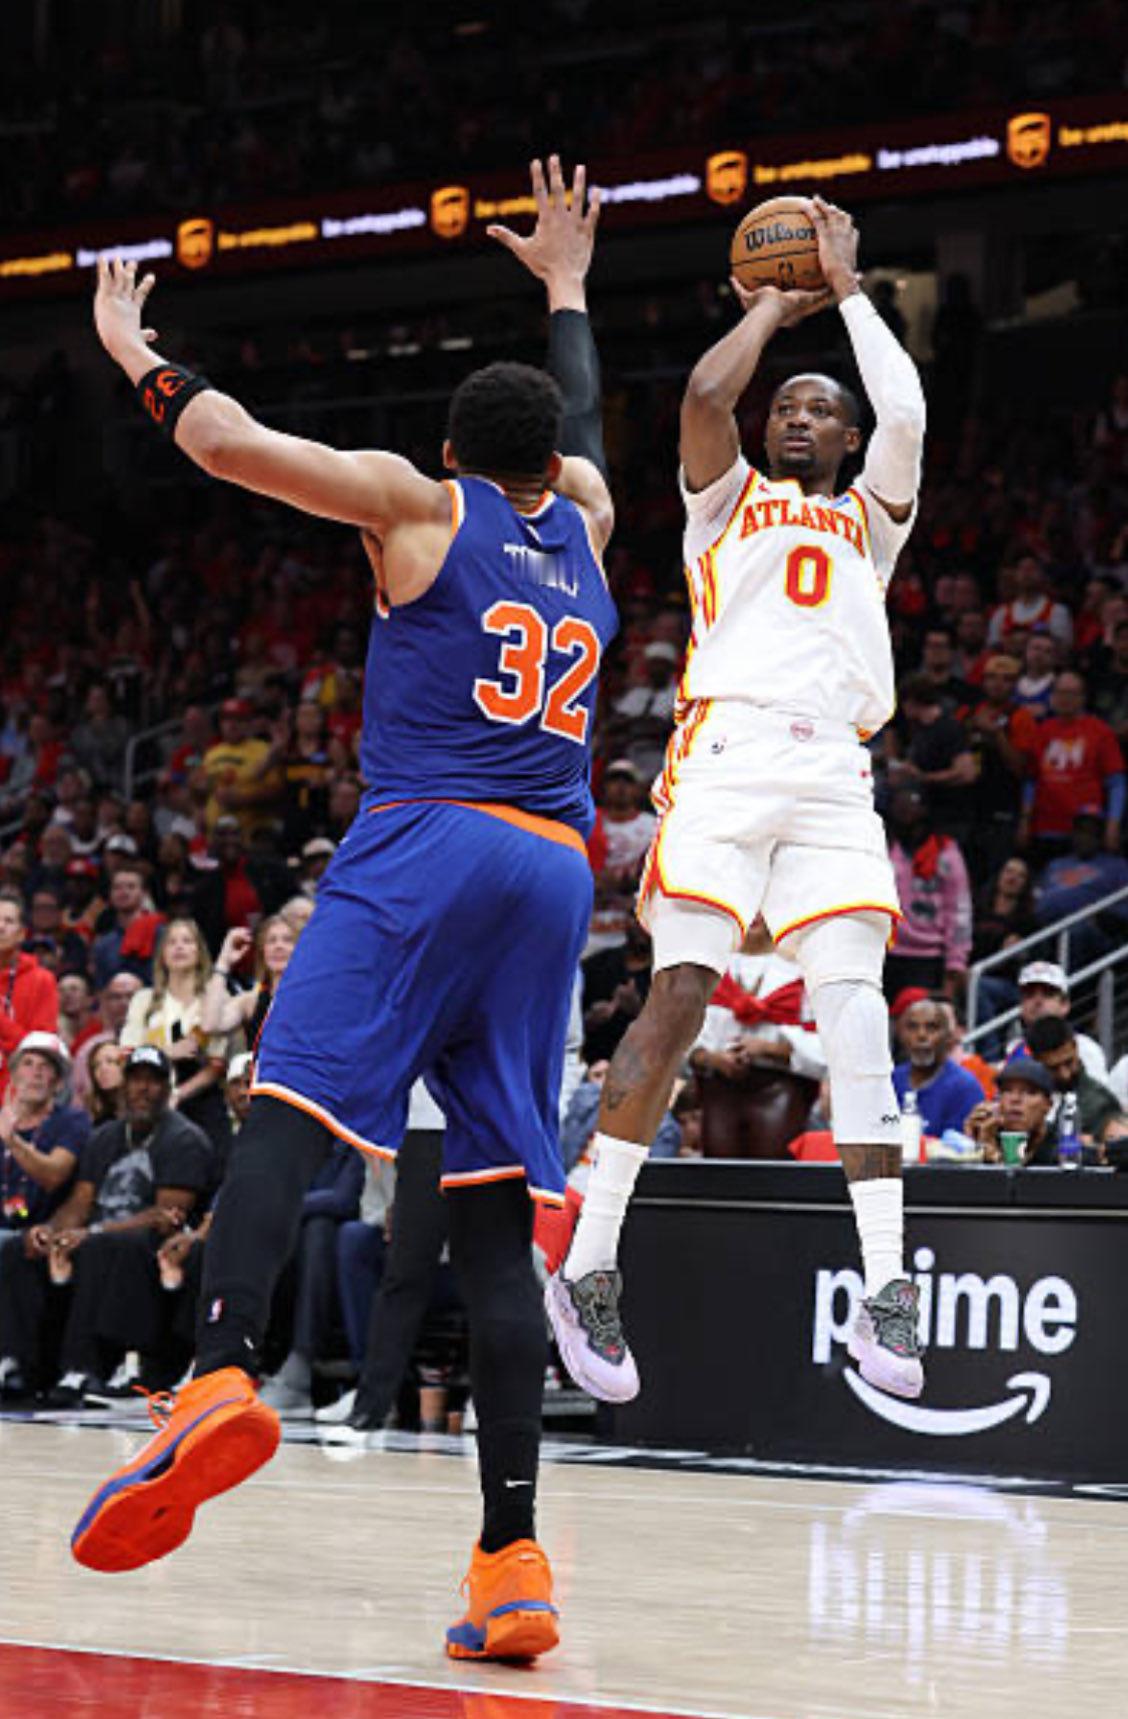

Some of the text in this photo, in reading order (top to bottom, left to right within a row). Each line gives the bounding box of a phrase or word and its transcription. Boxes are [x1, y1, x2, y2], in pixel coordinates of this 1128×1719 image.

[784, 543, 833, 609] 0
[472, 600, 600, 746] 32
[812, 1247, 1078, 1364] pime
